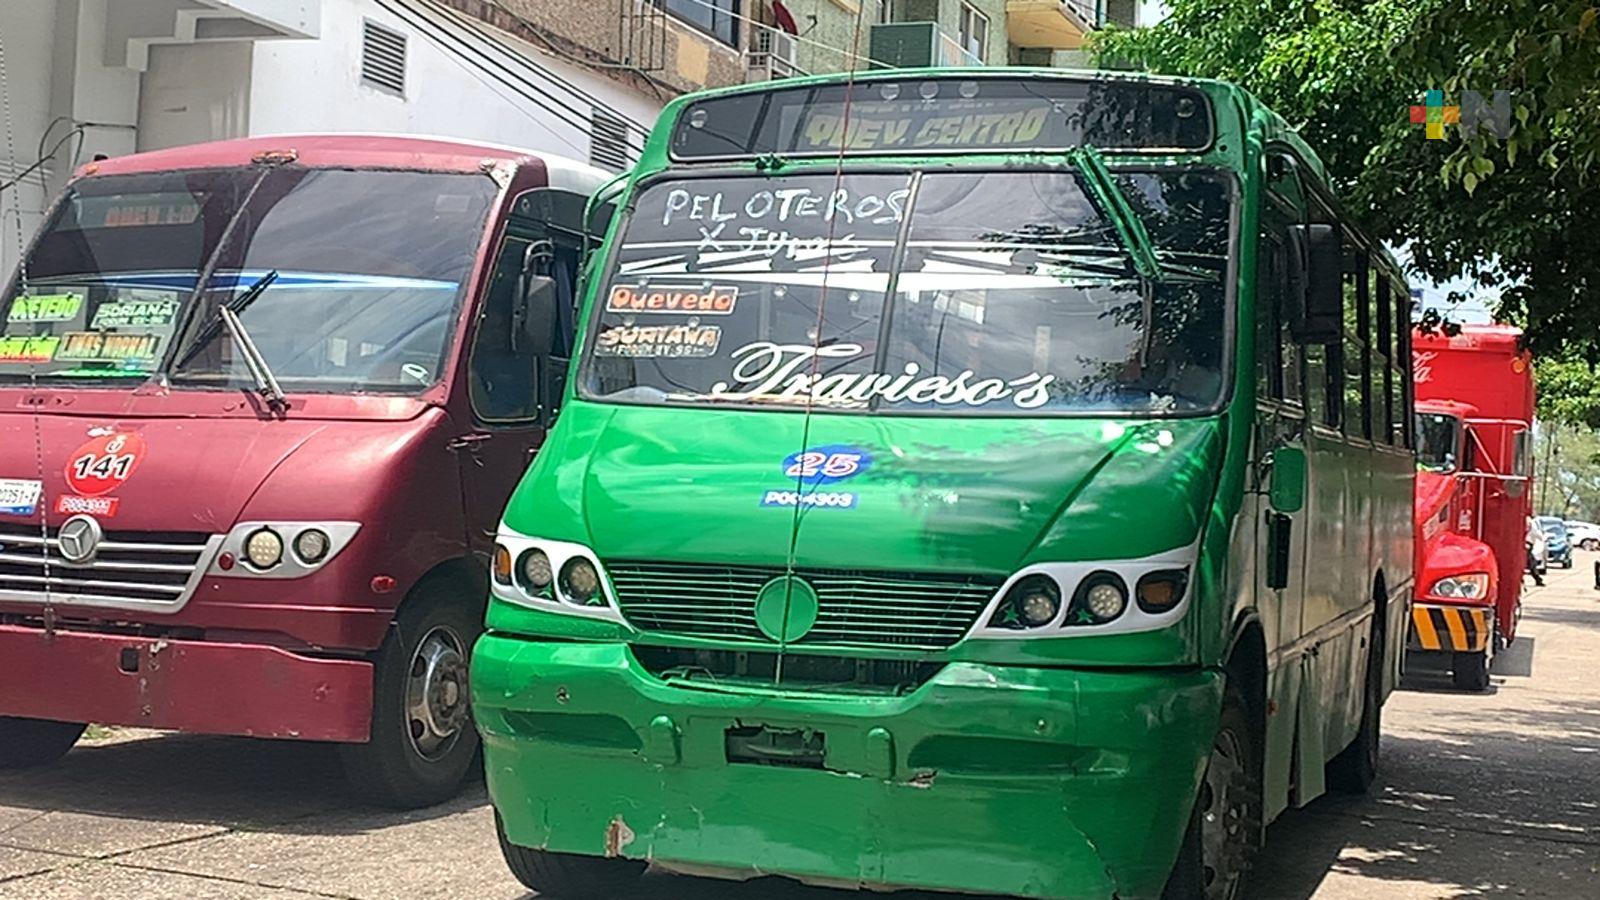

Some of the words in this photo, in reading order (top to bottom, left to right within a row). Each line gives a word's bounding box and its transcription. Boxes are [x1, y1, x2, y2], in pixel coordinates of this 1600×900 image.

[913, 107, 1050, 147] CENTRO
[96, 302, 174, 318] SORIANA
[611, 288, 731, 311] Quevedo
[73, 452, 136, 480] 141
[785, 452, 861, 477] 25
